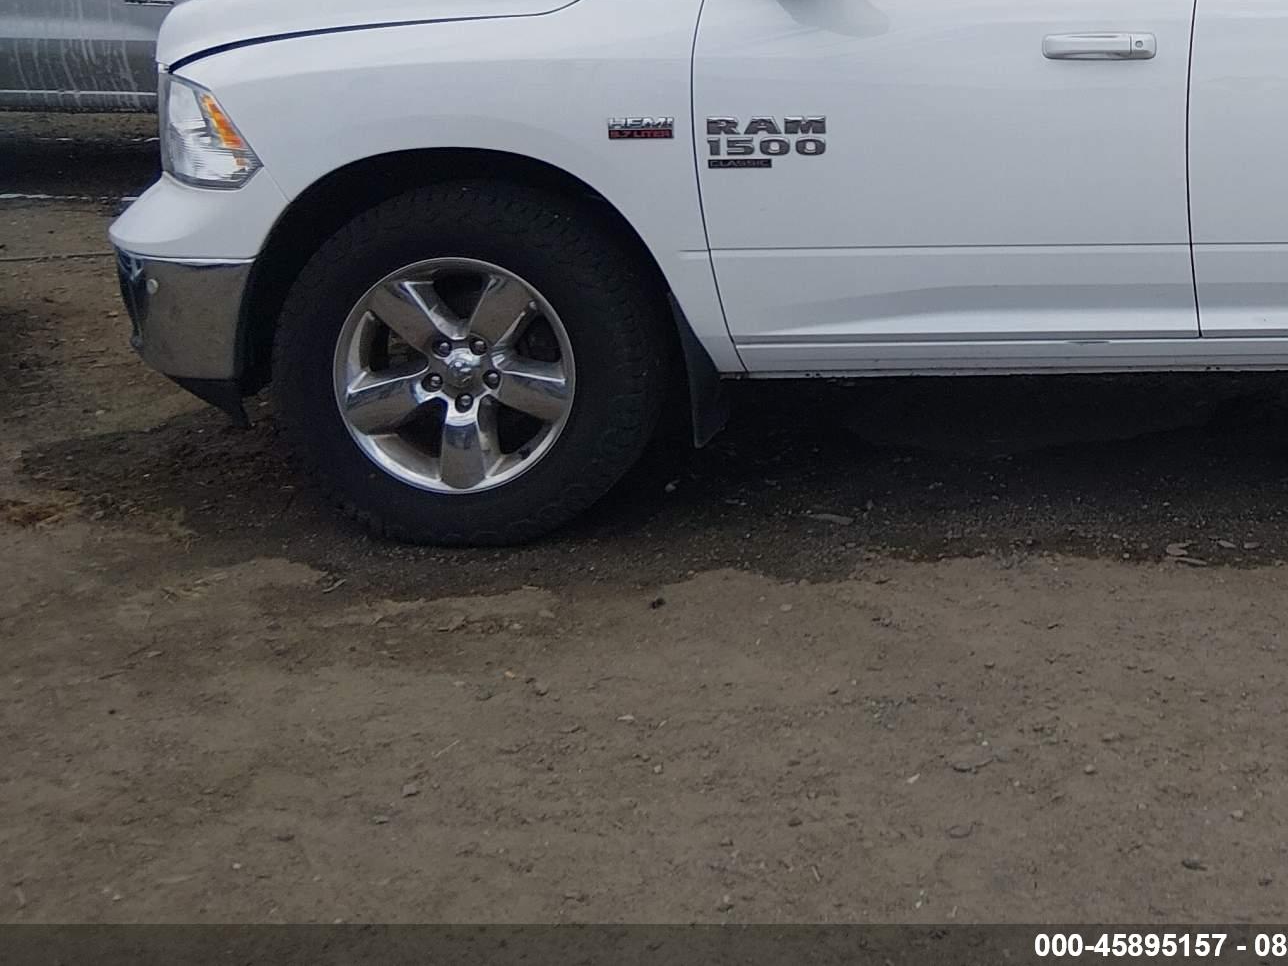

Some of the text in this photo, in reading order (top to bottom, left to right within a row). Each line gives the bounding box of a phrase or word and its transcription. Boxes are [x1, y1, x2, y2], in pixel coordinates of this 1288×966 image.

[608, 117, 673, 129] HEMI
[706, 115, 826, 135] RAM
[706, 137, 826, 156] 1500
[709, 159, 769, 167] CLASSIC
